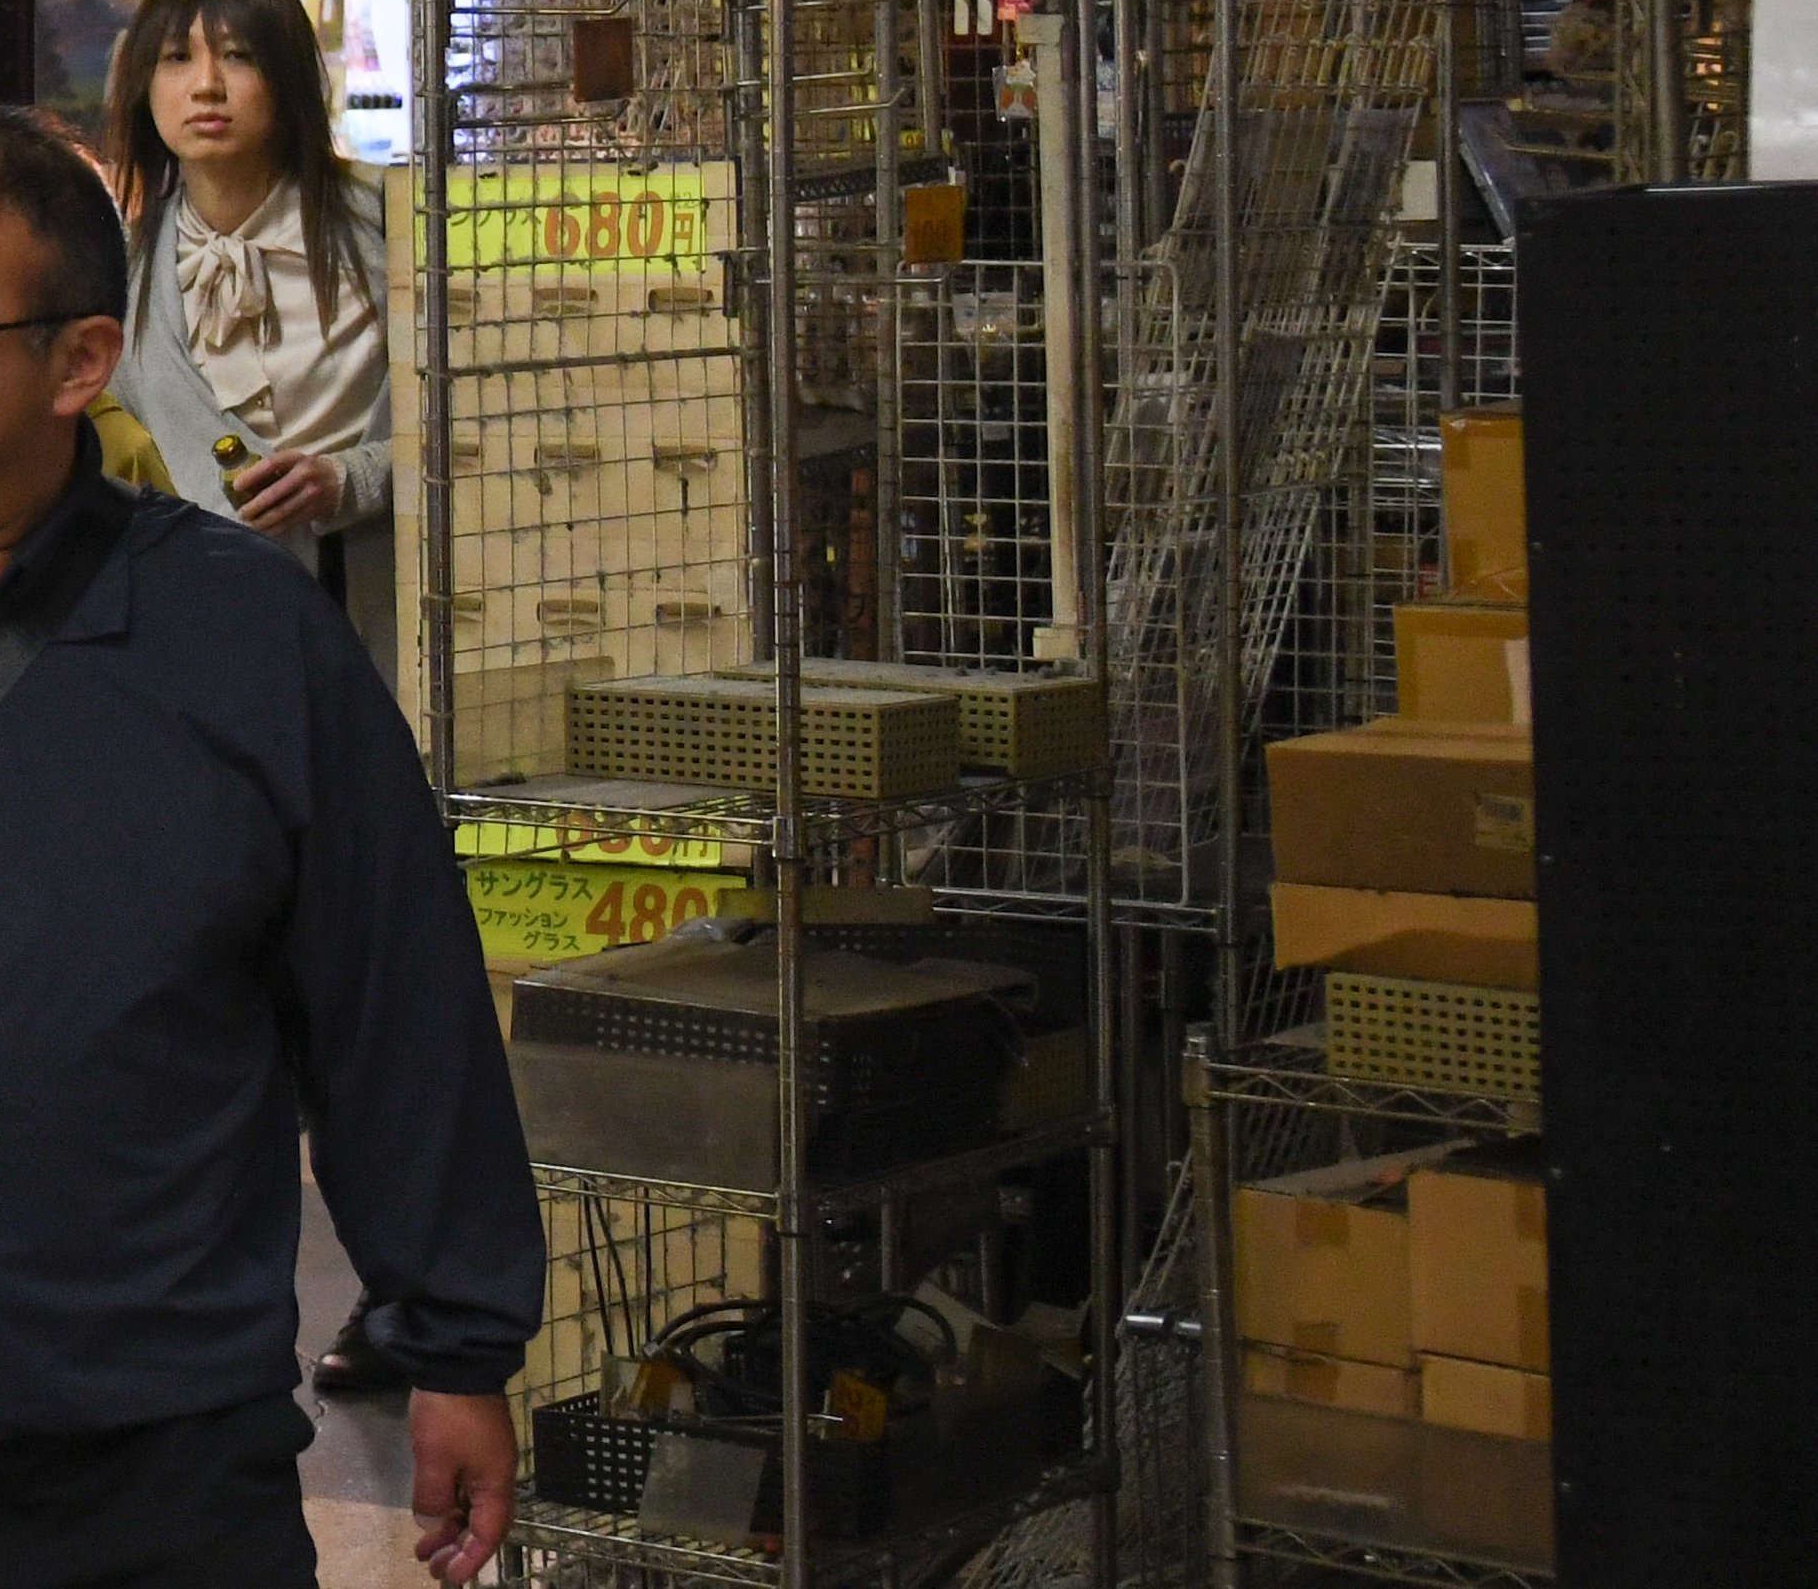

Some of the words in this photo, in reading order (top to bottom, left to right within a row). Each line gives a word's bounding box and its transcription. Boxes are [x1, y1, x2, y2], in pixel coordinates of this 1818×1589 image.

[478, 870, 593, 902] サングラス
[478, 907, 568, 929] ファッション
[523, 930, 580, 952] グラス
